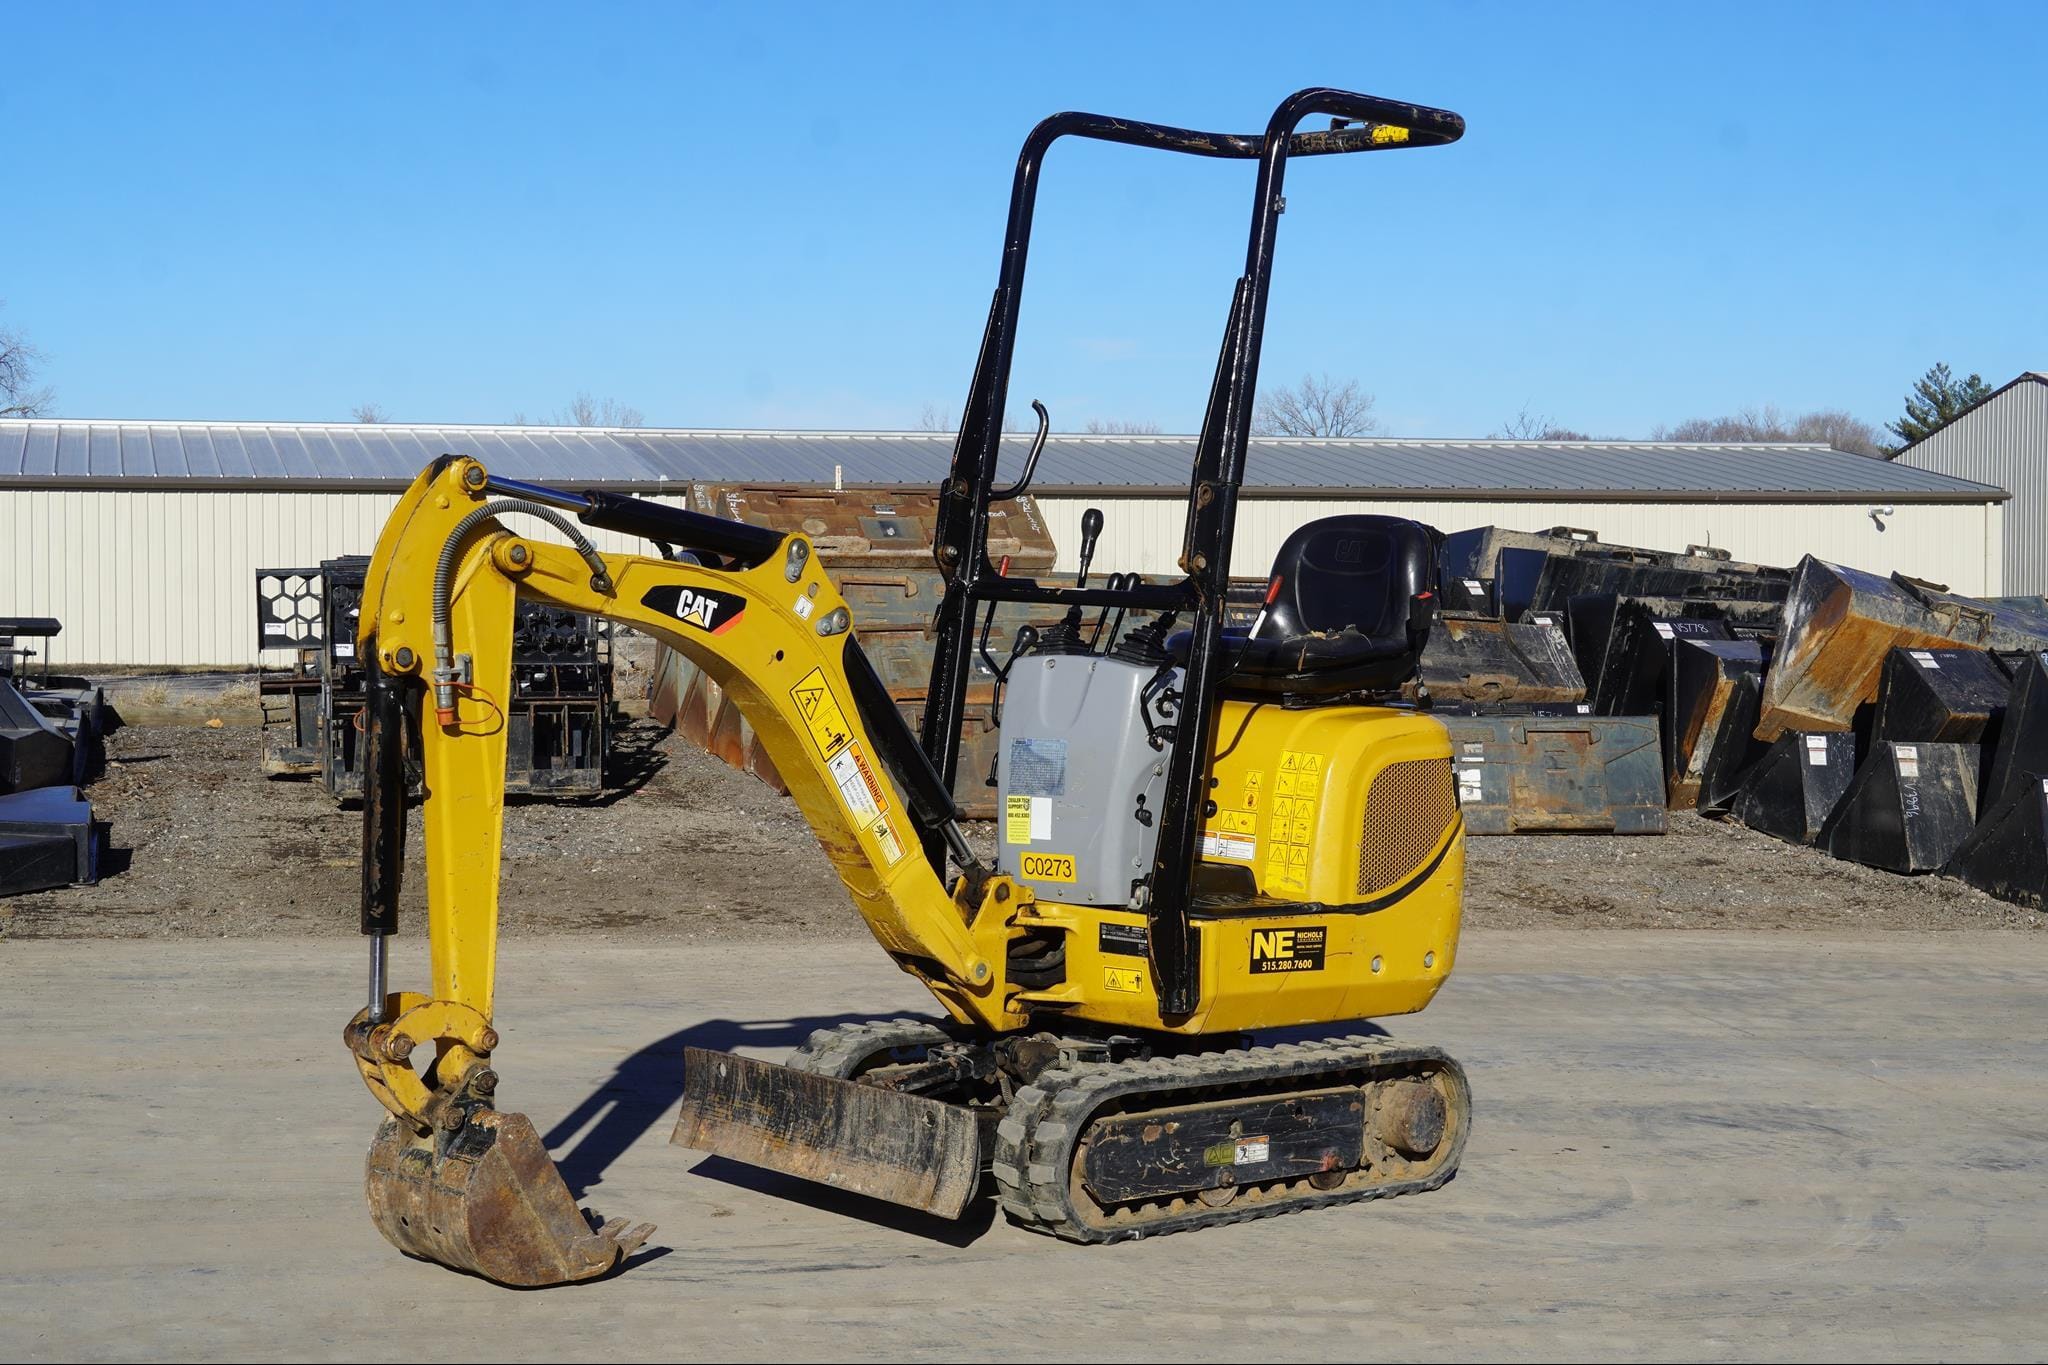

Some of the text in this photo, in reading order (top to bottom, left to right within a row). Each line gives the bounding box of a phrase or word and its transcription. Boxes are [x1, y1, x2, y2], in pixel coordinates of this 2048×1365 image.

[676, 589, 718, 629] CAT
[859, 762, 883, 803] WARNING
[1024, 856, 1072, 878] C0273
[1253, 930, 1295, 960] NE
[1296, 931, 1323, 939] NICHOLS
[1261, 959, 1312, 971] 515.280.7600
